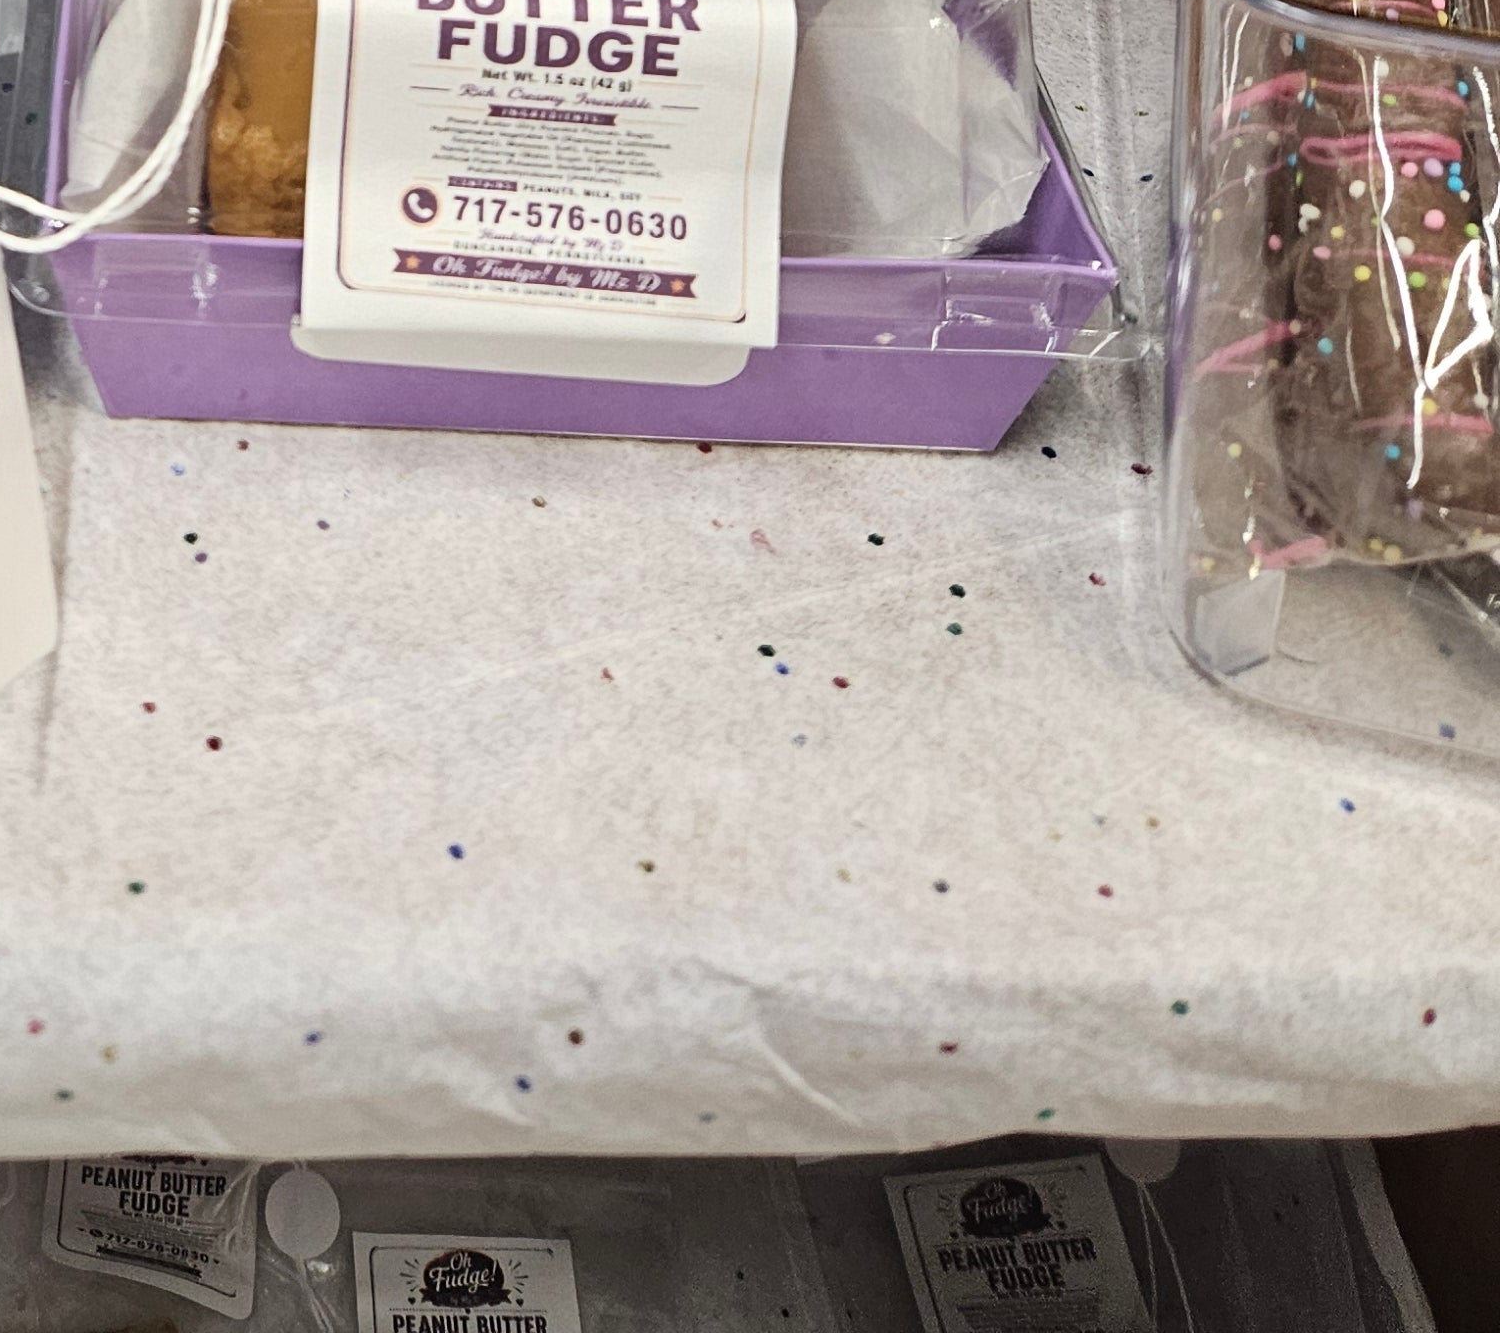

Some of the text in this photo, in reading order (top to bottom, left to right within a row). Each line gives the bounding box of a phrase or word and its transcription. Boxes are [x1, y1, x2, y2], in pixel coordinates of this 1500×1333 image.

[438, 17, 681, 77] FUDGE
[481, 68, 508, 81] Net
[513, 70, 537, 83] Wt.
[544, 72, 564, 85] 1.5
[568, 76, 585, 87] oz
[590, 74, 613, 92] (42
[453, 194, 687, 241] 717-576-0630
[432, 256, 468, 276] Oh
[474, 257, 554, 284] Fudge!
[555, 265, 583, 288] by
[589, 268, 631, 290] Mz
[635, 272, 662, 293] D
[81, 1165, 227, 1197] PEANUT BUTTER
[118, 1190, 190, 1218] FUDGE
[450, 1252, 473, 1271] Oh
[937, 1236, 1098, 1273] PEANUT BUTTER
[429, 1259, 498, 1293] Fudge!
[985, 1263, 1066, 1293] FUDGE
[392, 1314, 548, 1333] PEANUT BUTTER
